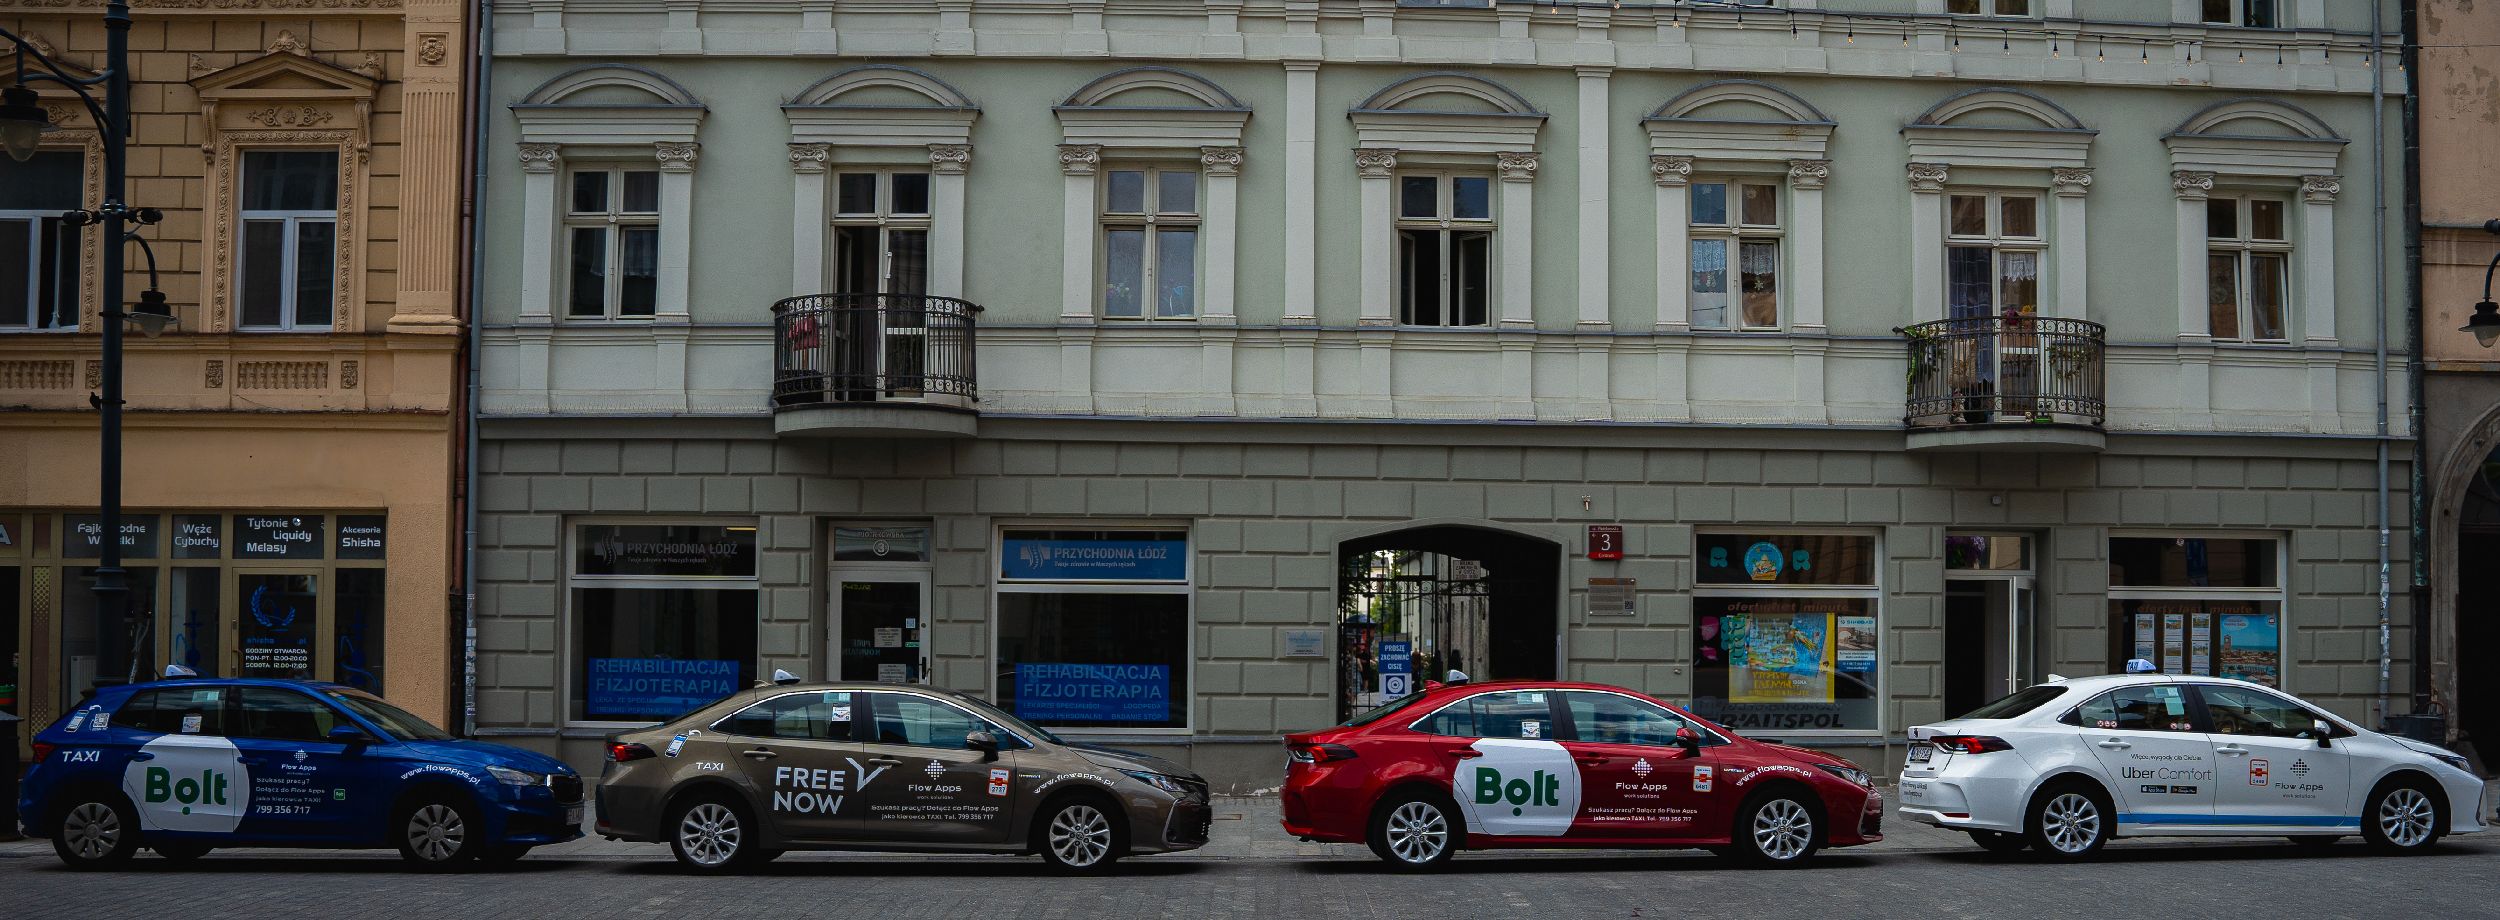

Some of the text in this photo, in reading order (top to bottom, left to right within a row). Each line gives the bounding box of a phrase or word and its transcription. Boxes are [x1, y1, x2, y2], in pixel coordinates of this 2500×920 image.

[78, 523, 146, 534] Fajk odne
[248, 518, 288, 529] Tytonie
[183, 524, 212, 536] Węże
[273, 530, 312, 542] Liquidy
[342, 526, 381, 534] Akcesoria
[175, 537, 219, 547] Cybuchy
[342, 537, 381, 547] Shisha
[1601, 534, 1611, 551] 3
[247, 543, 287, 554] Melasy
[627, 543, 706, 555] PRZYCHODNIA
[1054, 545, 1166, 560] PRZYCHODNIA ŁÓDŹ
[1384, 644, 1405, 653] PROSZĘ
[596, 659, 731, 675] REHABILITACJA
[1023, 665, 1161, 680] REHABILITACJA
[596, 678, 731, 693] FIZJOTERAPIA
[1023, 684, 1162, 698] FIZJOTERAPIA
[62, 750, 100, 763] TAXI
[695, 762, 725, 771] TAXI
[401, 764, 481, 785] www.flowapps.pl
[775, 766, 845, 791] FREE
[1736, 765, 1812, 787] www.flowapps.pl
[2121, 766, 2212, 781] Uber Comfort
[908, 784, 962, 793] Flow Apps
[1033, 772, 1115, 794] www.flowapps.pl
[1641, 783, 1668, 792] Apps
[2299, 783, 2324, 791] Apps
[145, 766, 228, 815] Bolt
[1475, 766, 1560, 817] Bolt
[773, 790, 844, 815] NOW
[256, 805, 311, 815] 799 356 717
